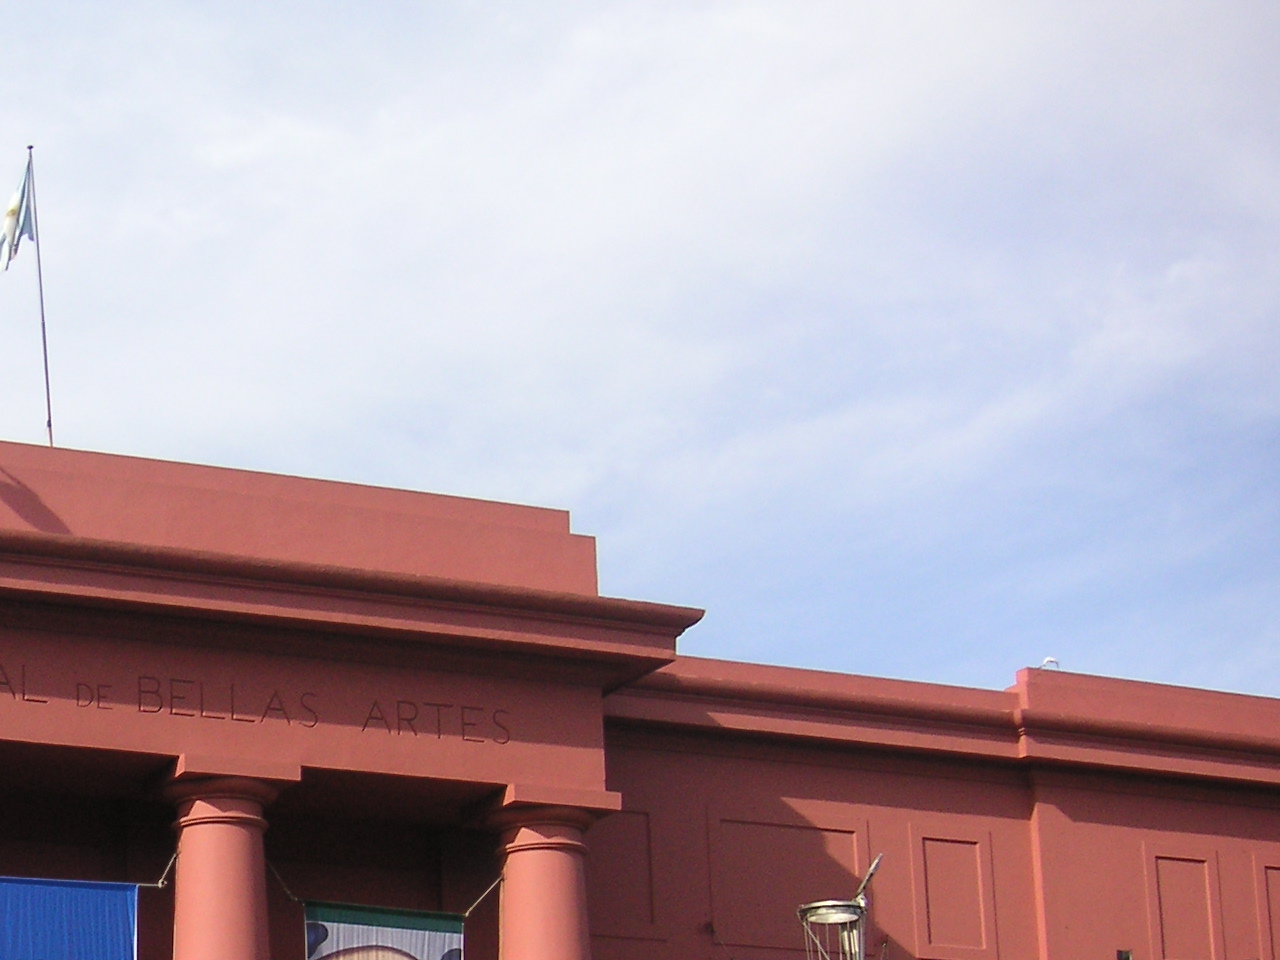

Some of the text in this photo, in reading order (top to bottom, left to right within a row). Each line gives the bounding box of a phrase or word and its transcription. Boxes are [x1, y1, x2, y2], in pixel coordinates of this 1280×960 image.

[75, 682, 113, 710] DE
[137, 675, 319, 728] BELLAS
[361, 700, 512, 745] ARTES
